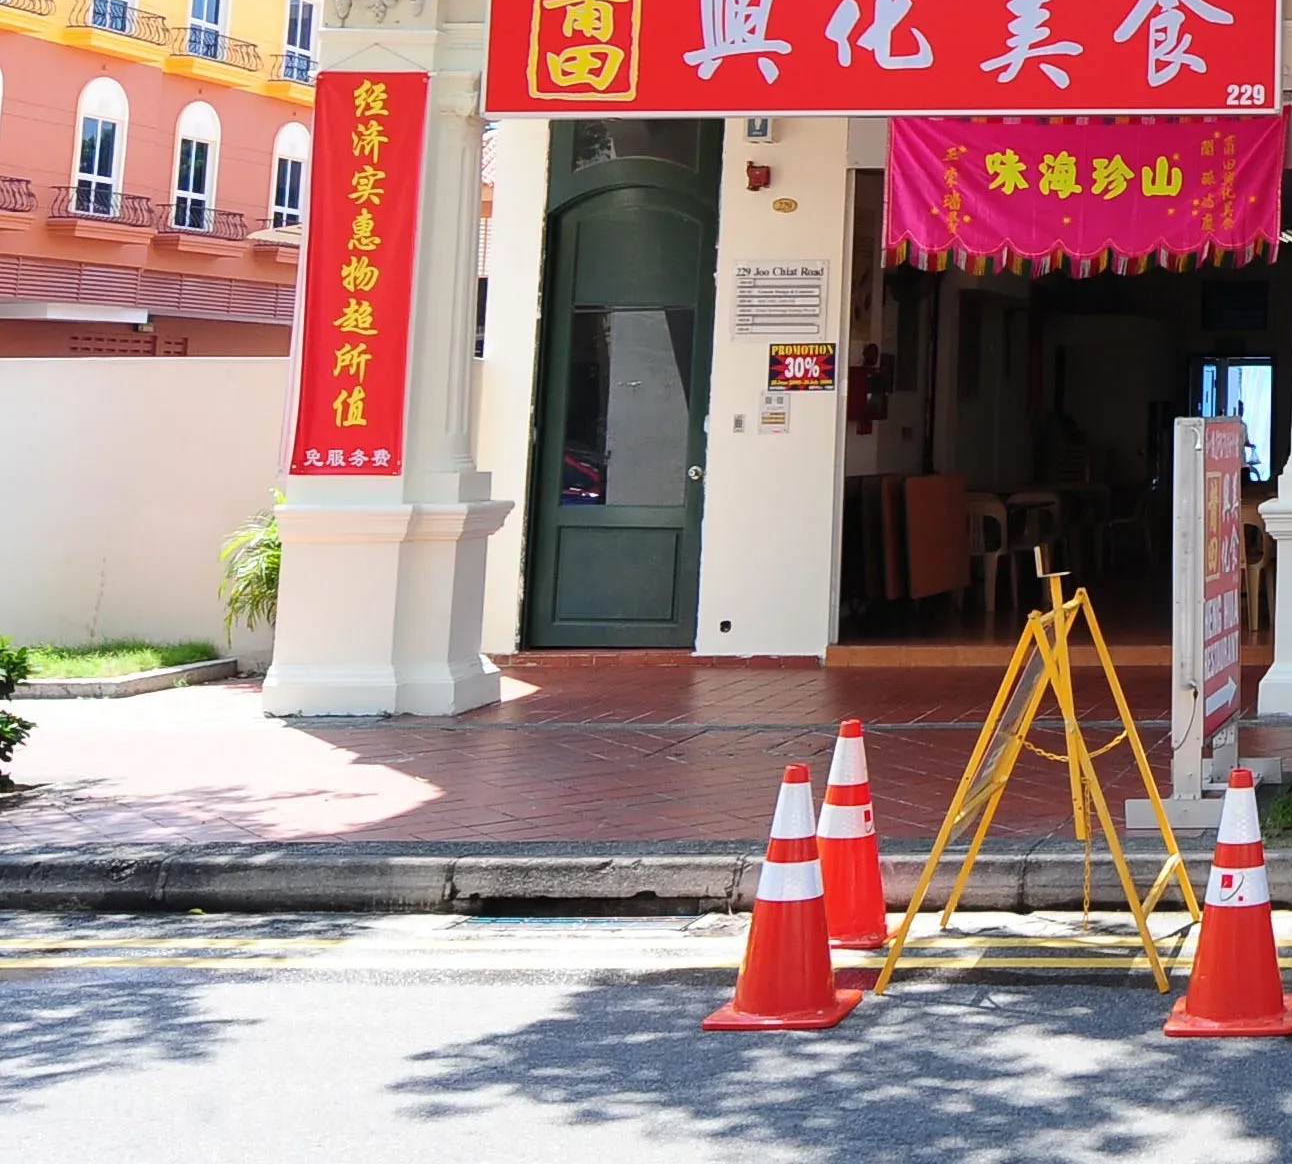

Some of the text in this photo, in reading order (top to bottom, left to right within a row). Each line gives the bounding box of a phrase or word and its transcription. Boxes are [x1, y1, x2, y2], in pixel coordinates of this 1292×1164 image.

[1225, 84, 1267, 107] 229
[736, 266, 824, 277] 229 Joo Chiat Road
[771, 344, 834, 356] PROMOTION
[784, 356, 820, 378] 30%
[303, 448, 392, 468] 免服务费
